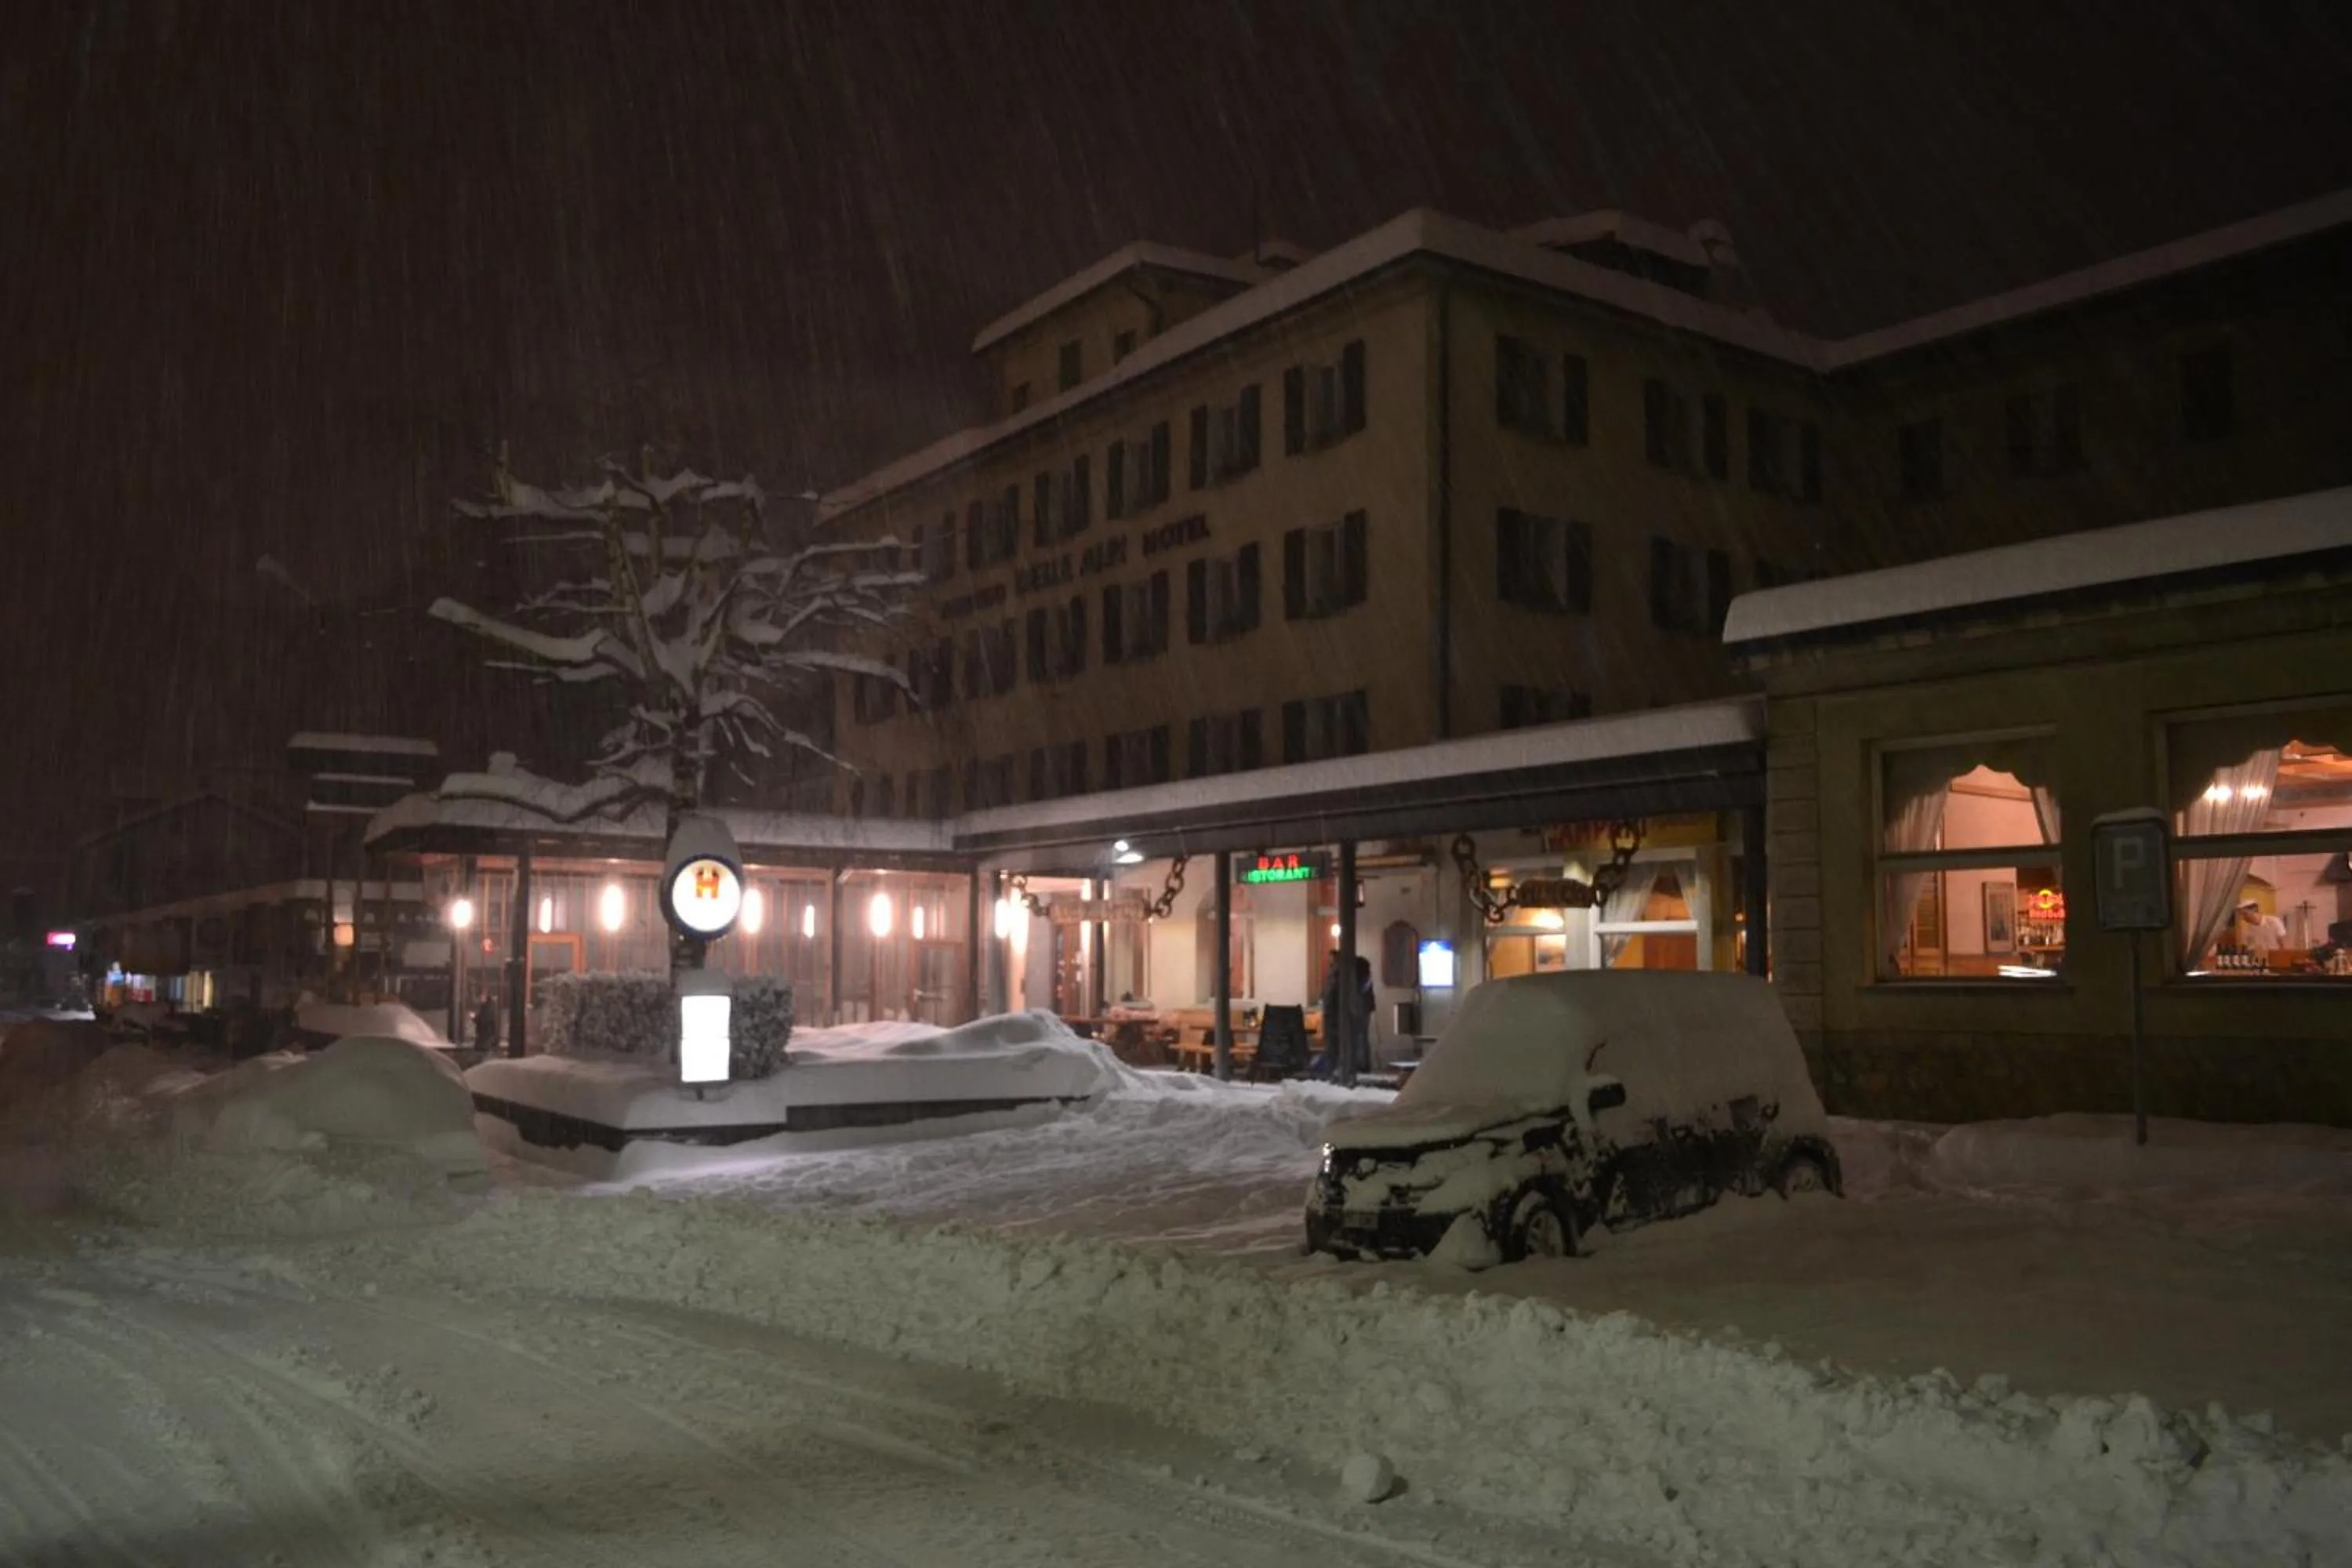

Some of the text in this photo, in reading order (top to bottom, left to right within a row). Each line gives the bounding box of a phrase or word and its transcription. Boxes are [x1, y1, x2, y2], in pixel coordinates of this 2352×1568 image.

[1142, 511, 1210, 557] HOTEL
[1258, 853, 1299, 869] BAR
[2113, 837, 2145, 889] P
[695, 867, 719, 898] H
